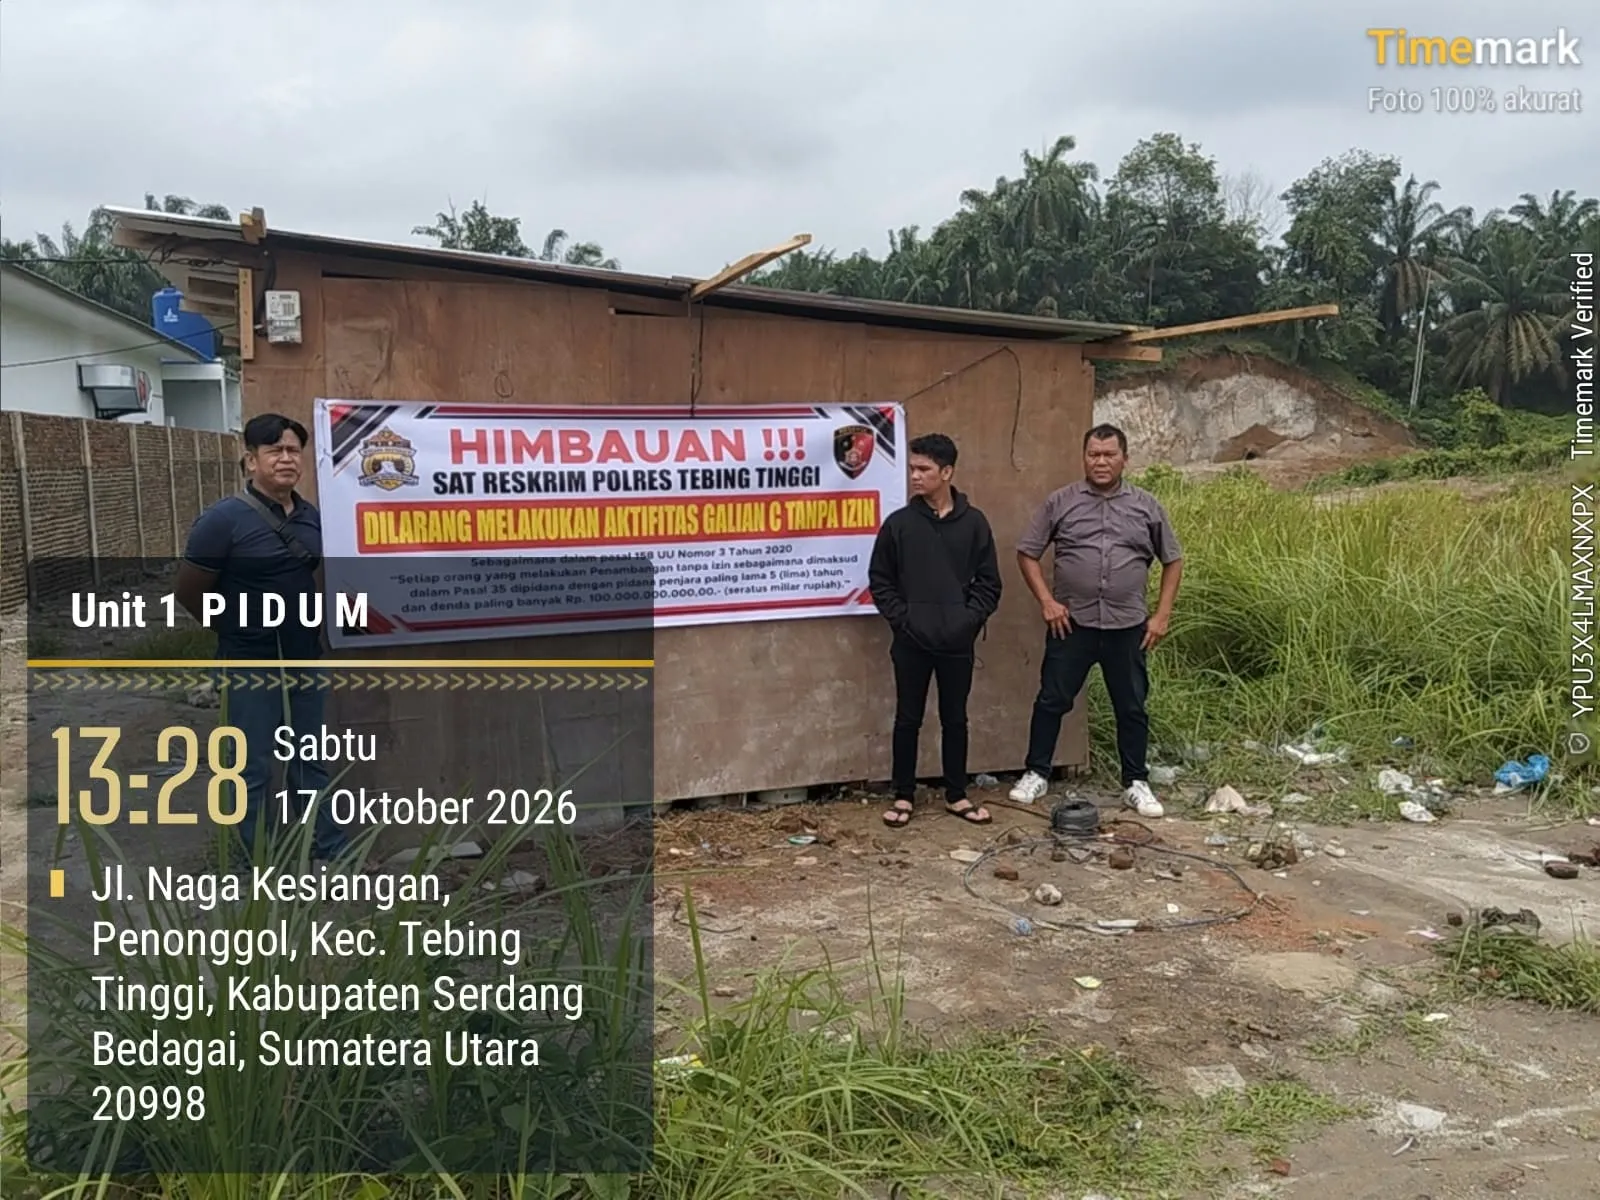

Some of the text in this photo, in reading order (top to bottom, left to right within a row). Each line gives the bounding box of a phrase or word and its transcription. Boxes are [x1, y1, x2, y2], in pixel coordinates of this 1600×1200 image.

[450, 428, 806, 465] HIMBAUAN !!!
[433, 471, 476, 495] SAT
[484, 470, 586, 494] RESKRIM
[593, 469, 672, 492] POLRES
[678, 467, 750, 490] TEBING
[756, 466, 820, 488] TINGGI
[363, 498, 876, 545] DILARANG MELAKUKAN AKTIFITAS GALIAN C TANPA IZIN
[443, 572, 481, 583] orang
[485, 569, 516, 581] yang
[519, 566, 587, 578] melakukan
[590, 563, 673, 576] Penambangan
[676, 562, 709, 573] tanpa
[711, 560, 731, 570] izin
[733, 557, 803, 569] sebagaimana
[806, 554, 858, 565] dimaksud
[471, 544, 793, 567] Sebagaimana dalam pasal 158 UU Nomor 3 Tahun 2020
[409, 566, 843, 598] dalam Pasal 35 dipidana dengan pidana penjara paling lama 5 (lima) tahun
[401, 603, 427, 613] dan
[430, 600, 470, 611] denda
[474, 599, 513, 610] paling
[517, 596, 562, 608] banyak
[565, 594, 586, 605] Rp.
[724, 583, 768, 596] (seratus
